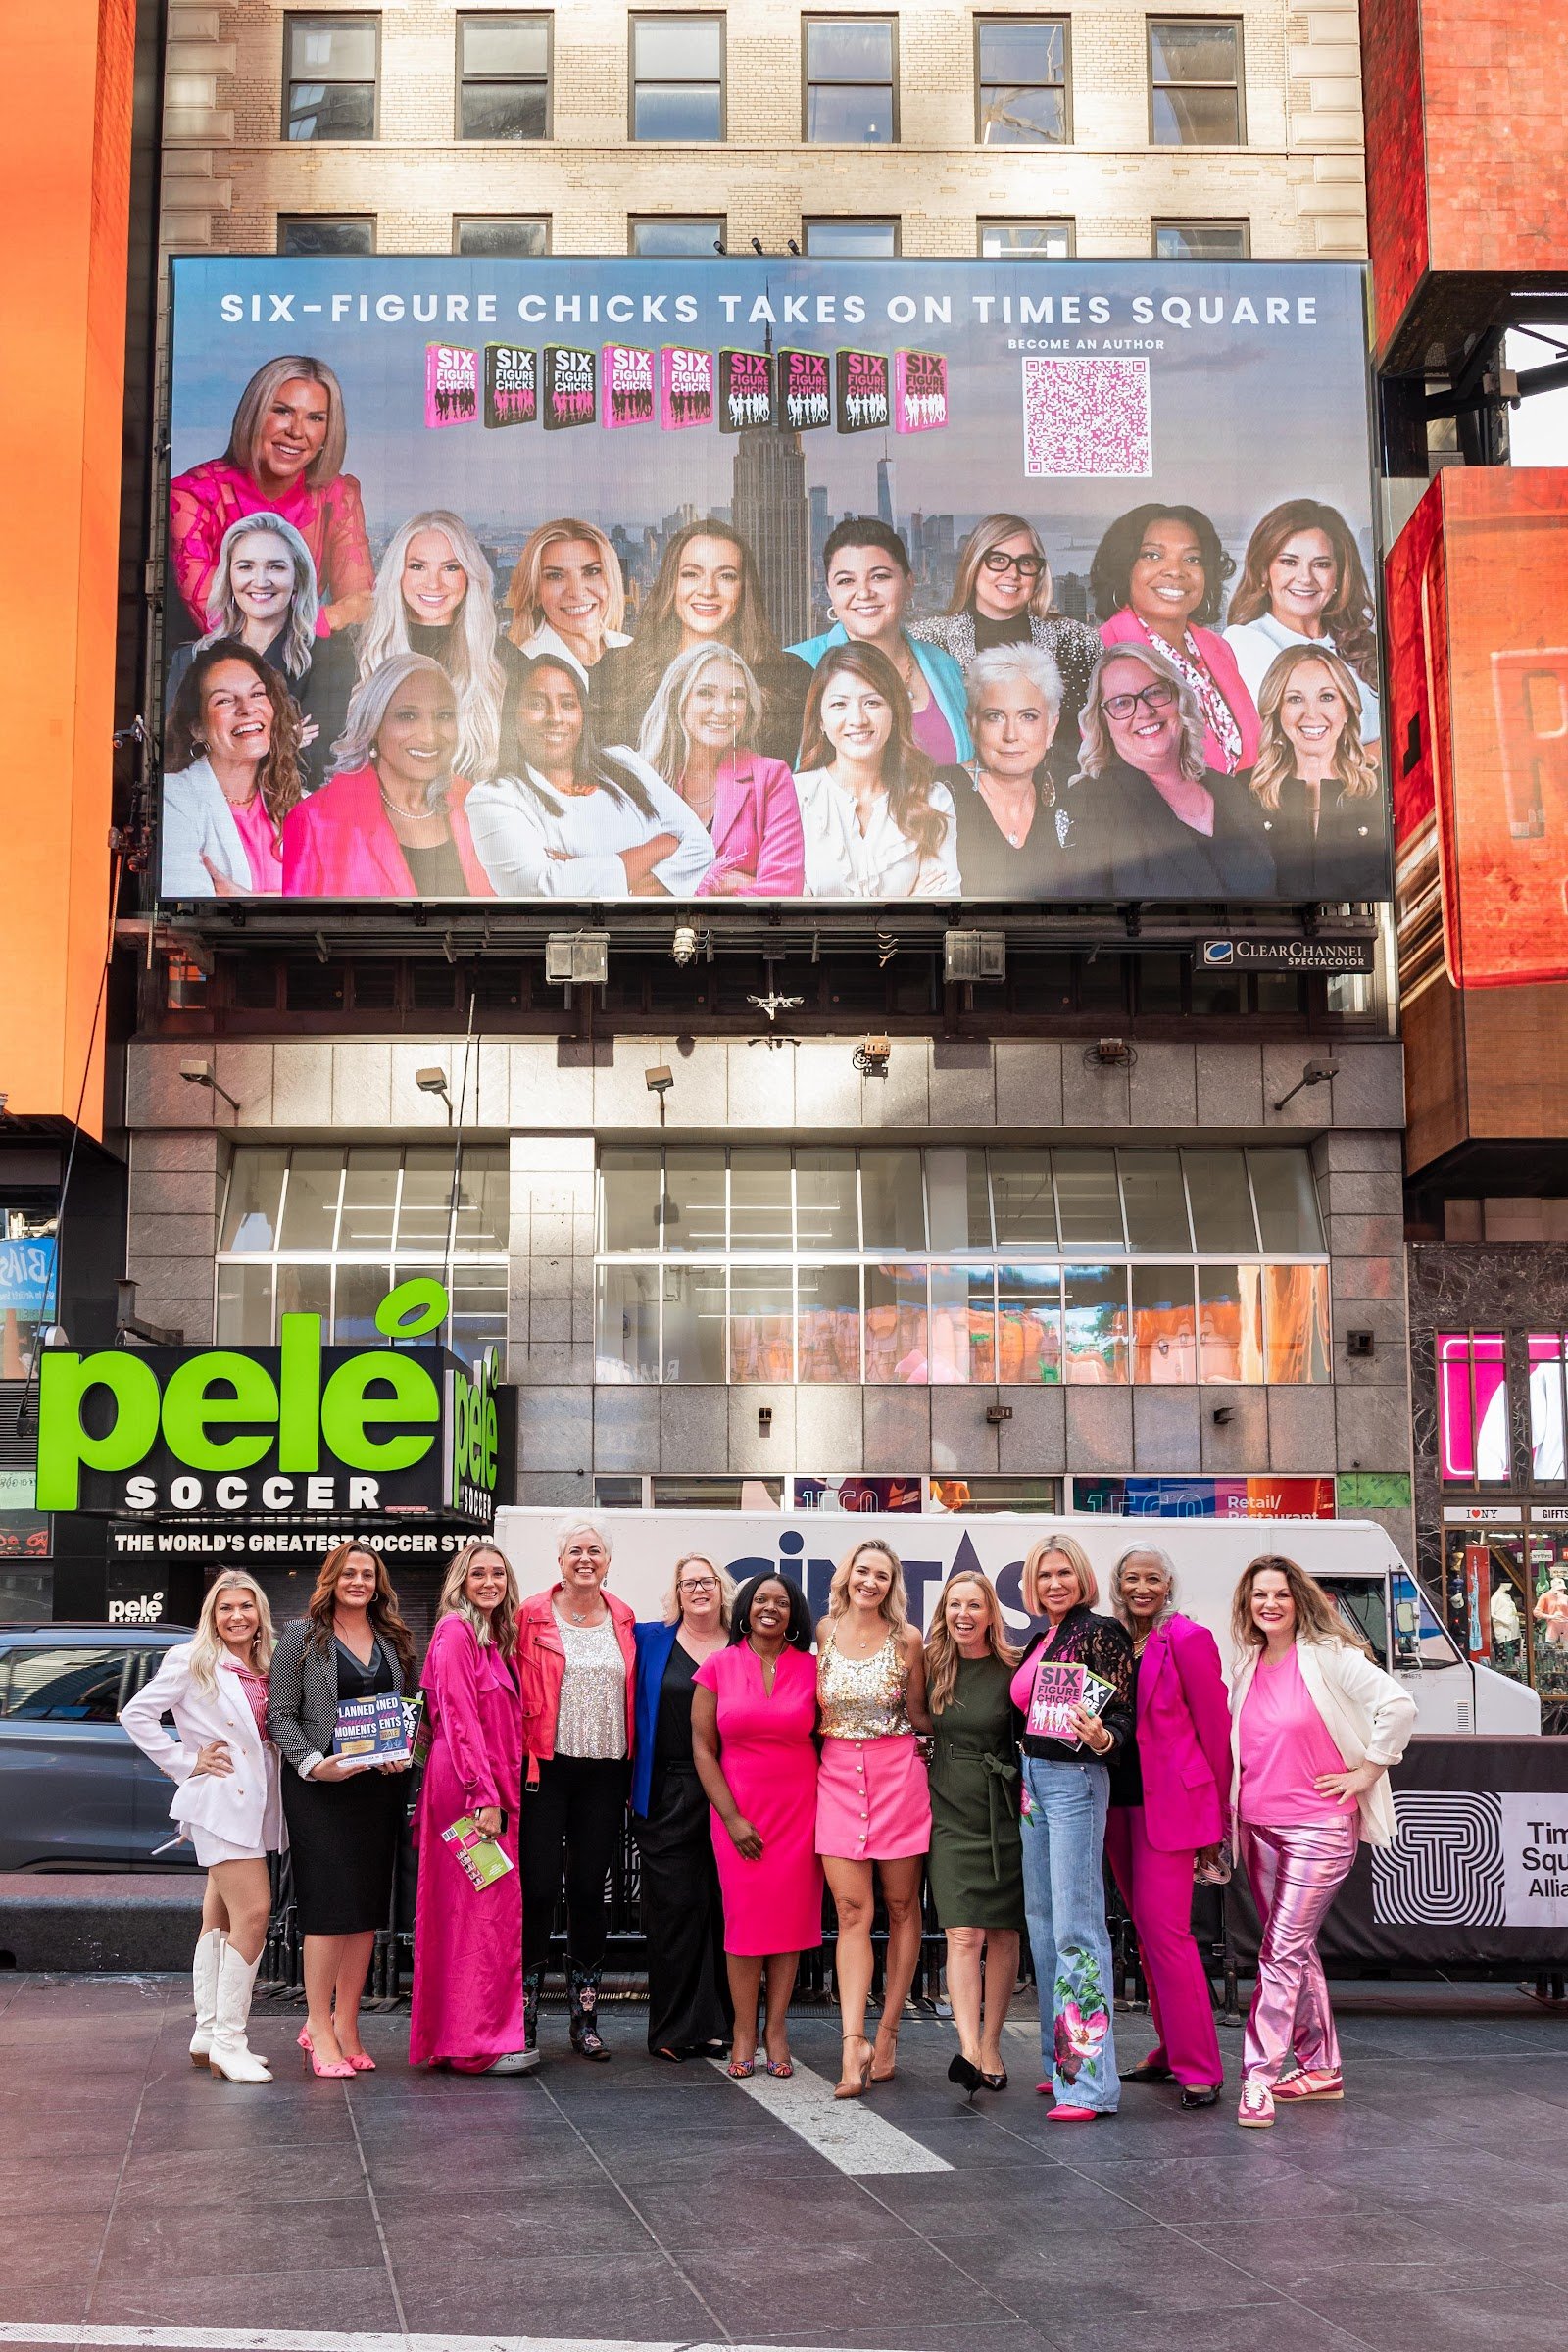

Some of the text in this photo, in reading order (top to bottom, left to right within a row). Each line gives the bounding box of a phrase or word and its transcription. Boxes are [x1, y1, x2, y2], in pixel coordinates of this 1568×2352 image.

[220, 294, 1317, 328] SIX-FIGURE CHICKS TAKES ON TIMES SQUARE
[1008, 339, 1165, 350] BECOME AN AUTHOR
[436, 369, 476, 381] FIGURE
[495, 369, 535, 381] FIGURE
[554, 370, 594, 383] FIGURE
[612, 369, 652, 381] FIGURE
[671, 371, 710, 383] FIGURE
[730, 375, 768, 385] FIGURE
[789, 375, 827, 385] FIGURE
[847, 375, 886, 385] FIGURE
[906, 375, 944, 386] FIGURE
[436, 380, 476, 390] CHICKS
[495, 380, 535, 390] CHICKS
[554, 382, 594, 392] CHICKS
[612, 380, 653, 390] CHICKS
[671, 382, 710, 392] CHICKS
[730, 385, 769, 395] CHICKS
[789, 385, 827, 395] CHICKS
[847, 385, 886, 395] CHICKS
[906, 385, 944, 395] CHICKS
[1288, 957, 1365, 966] SPECTACOLOR
[36, 1277, 449, 1511] pelé
[453, 1346, 499, 1509] pelé
[125, 1476, 381, 1510] SOCCER
[464, 1485, 492, 1520] SOCCER
[1227, 1494, 1281, 1509] Retail/
[115, 1534, 154, 1551] THE
[158, 1534, 245, 1551] WORLD'S
[358, 1535, 437, 1551] SOCCER
[109, 1592, 164, 1622] pelé
[1038, 1685, 1080, 1697] FIGURE
[337, 1704, 375, 1718] LANNED
[334, 1723, 377, 1738] MOMENTS
